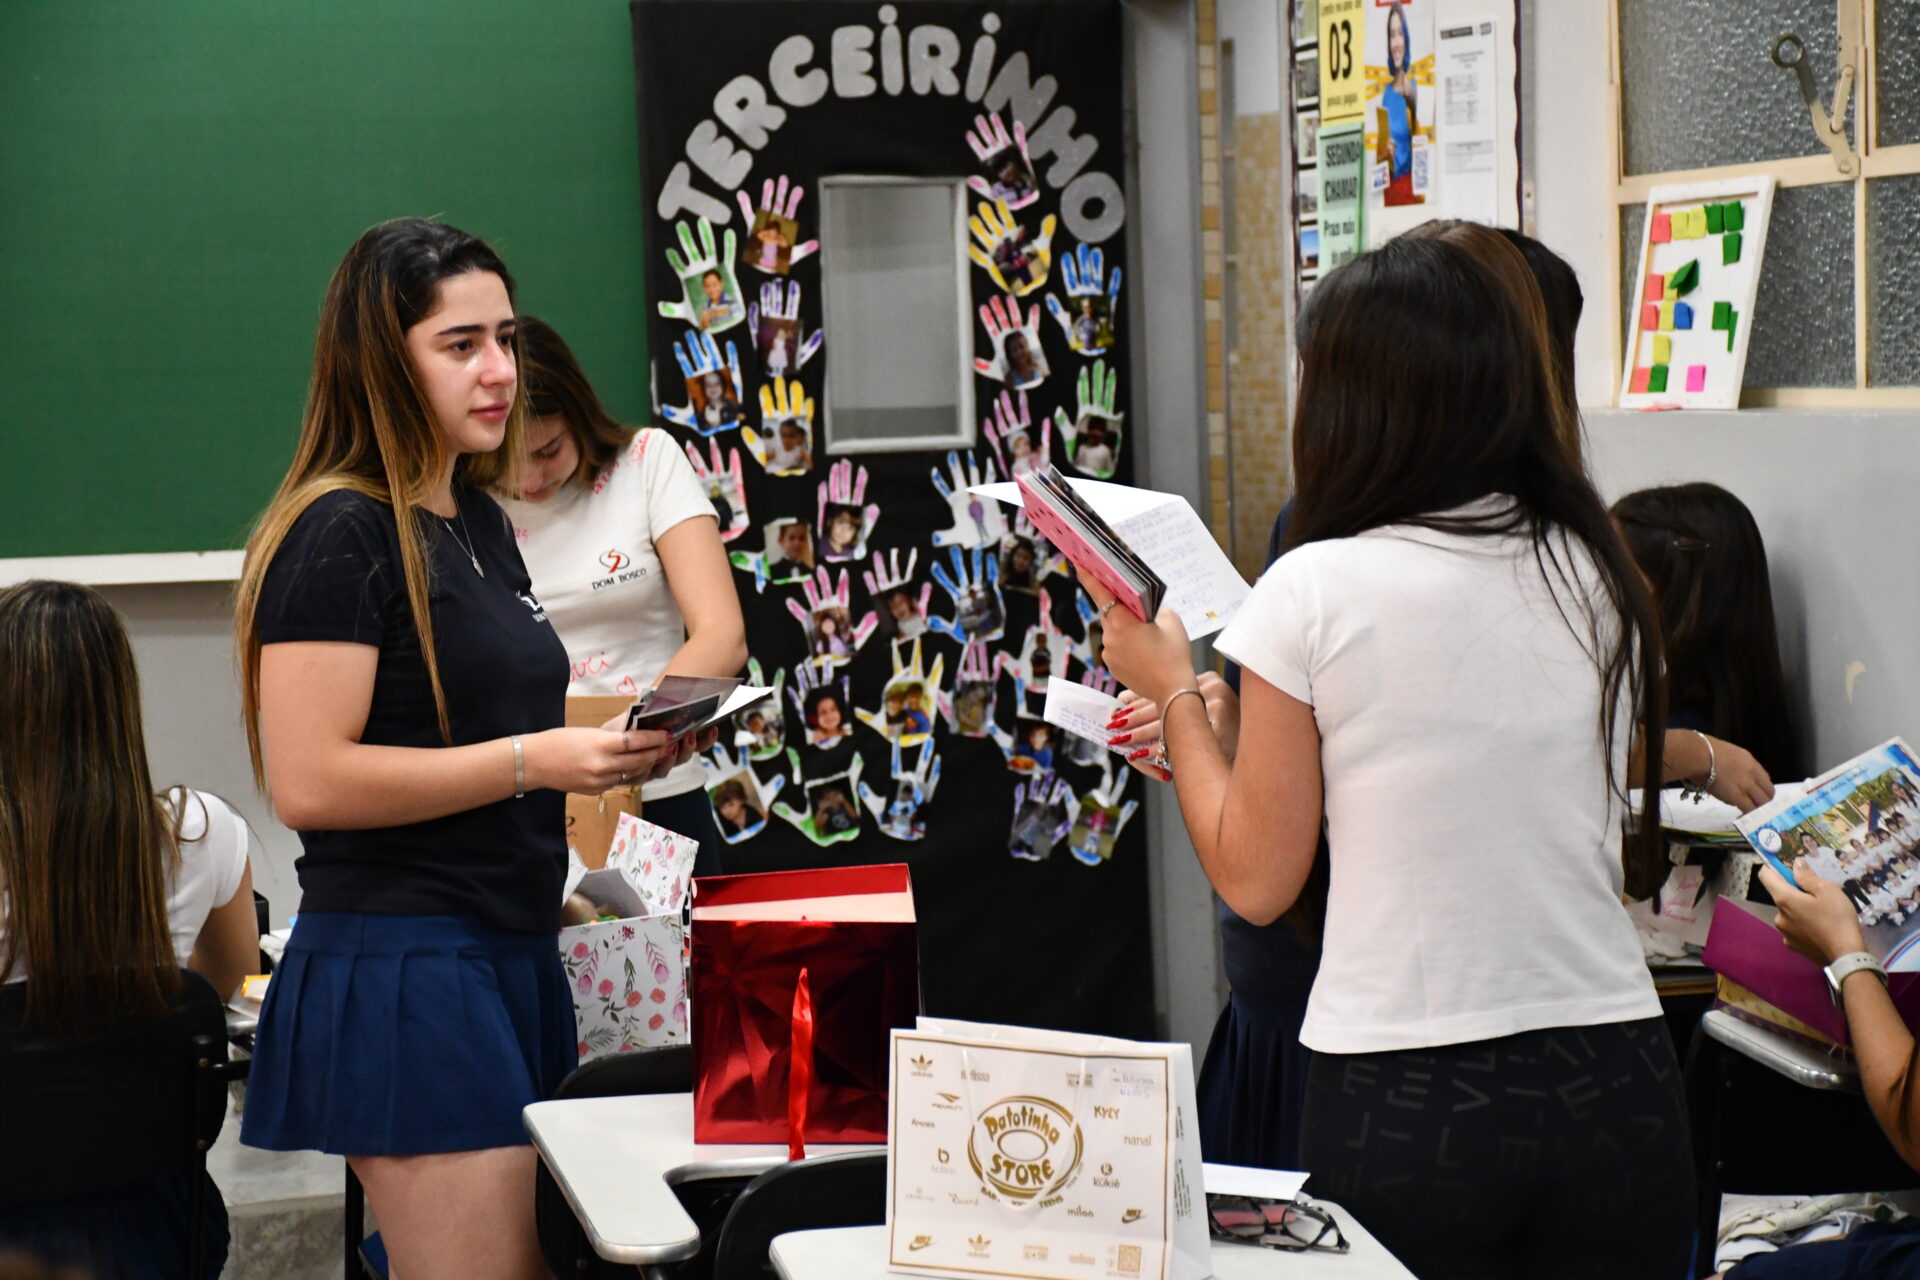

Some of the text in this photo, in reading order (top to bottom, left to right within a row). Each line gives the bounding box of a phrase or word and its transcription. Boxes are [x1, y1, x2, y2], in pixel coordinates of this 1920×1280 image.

[1329, 20, 1353, 81] 03
[592, 567, 647, 591] DOM BOSCO
[990, 1153, 1055, 1186] STORE
